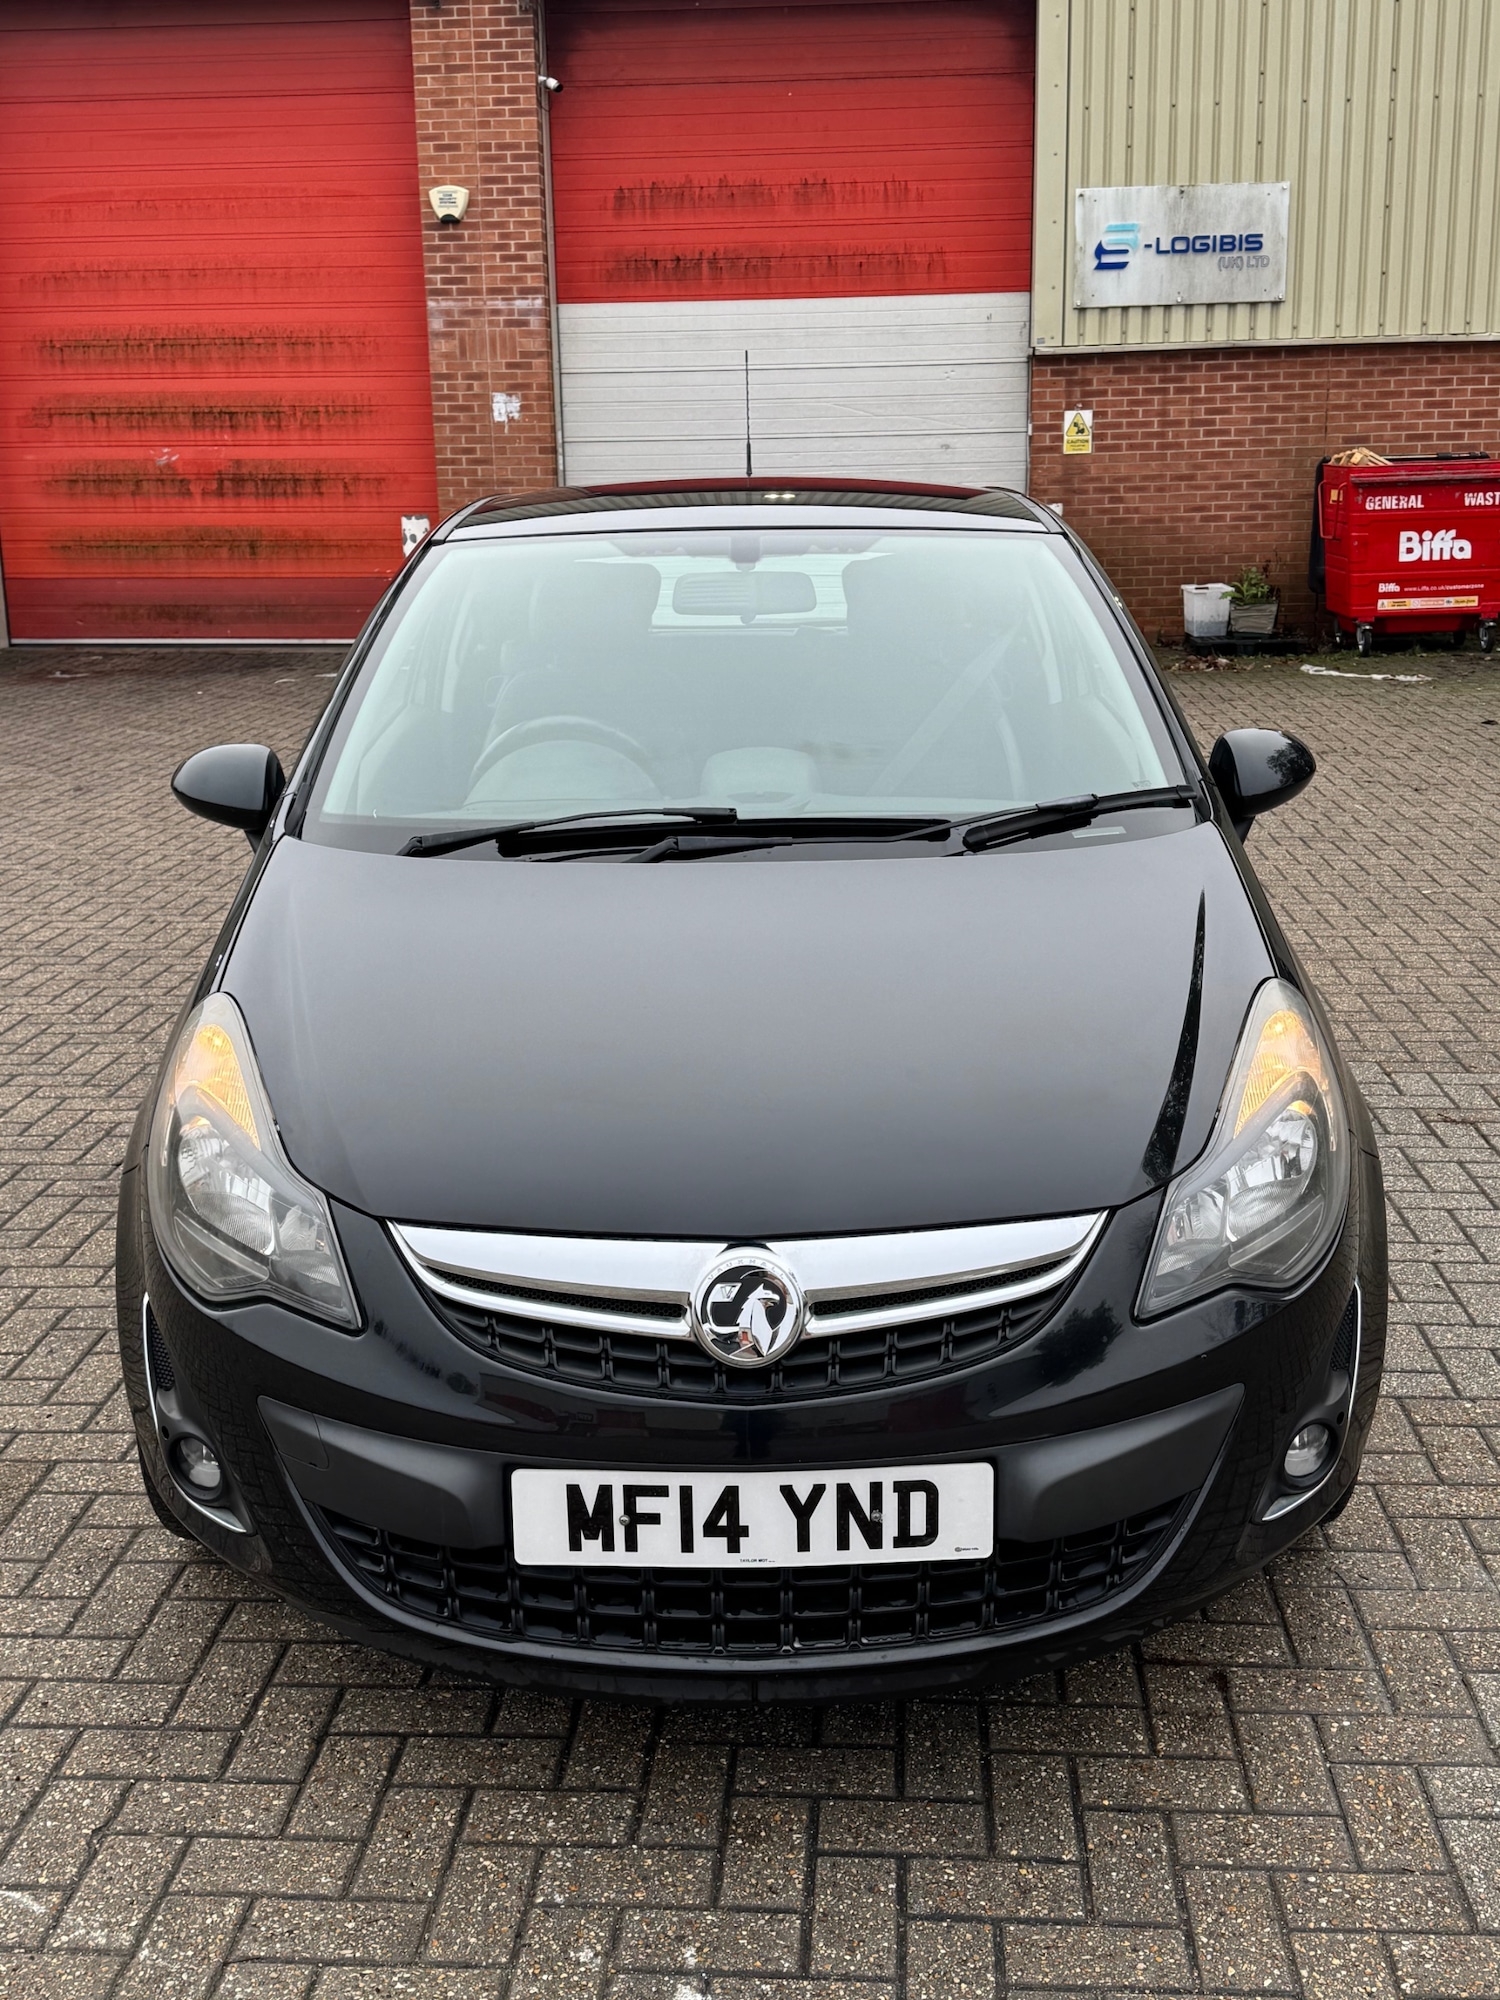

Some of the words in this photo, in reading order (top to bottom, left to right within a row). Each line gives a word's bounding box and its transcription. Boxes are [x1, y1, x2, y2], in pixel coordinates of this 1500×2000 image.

[1217, 255, 1244, 272] (UK)
[1246, 255, 1271, 268] LTD
[1365, 495, 1424, 511] GENERAL
[1464, 491, 1500, 507] WAST
[1398, 529, 1472, 562] Biffa
[1378, 583, 1400, 593] Biffa
[707, 1259, 785, 1281] VAUXHALL
[565, 1483, 750, 1554] MF14
[779, 1479, 940, 1553] YND
